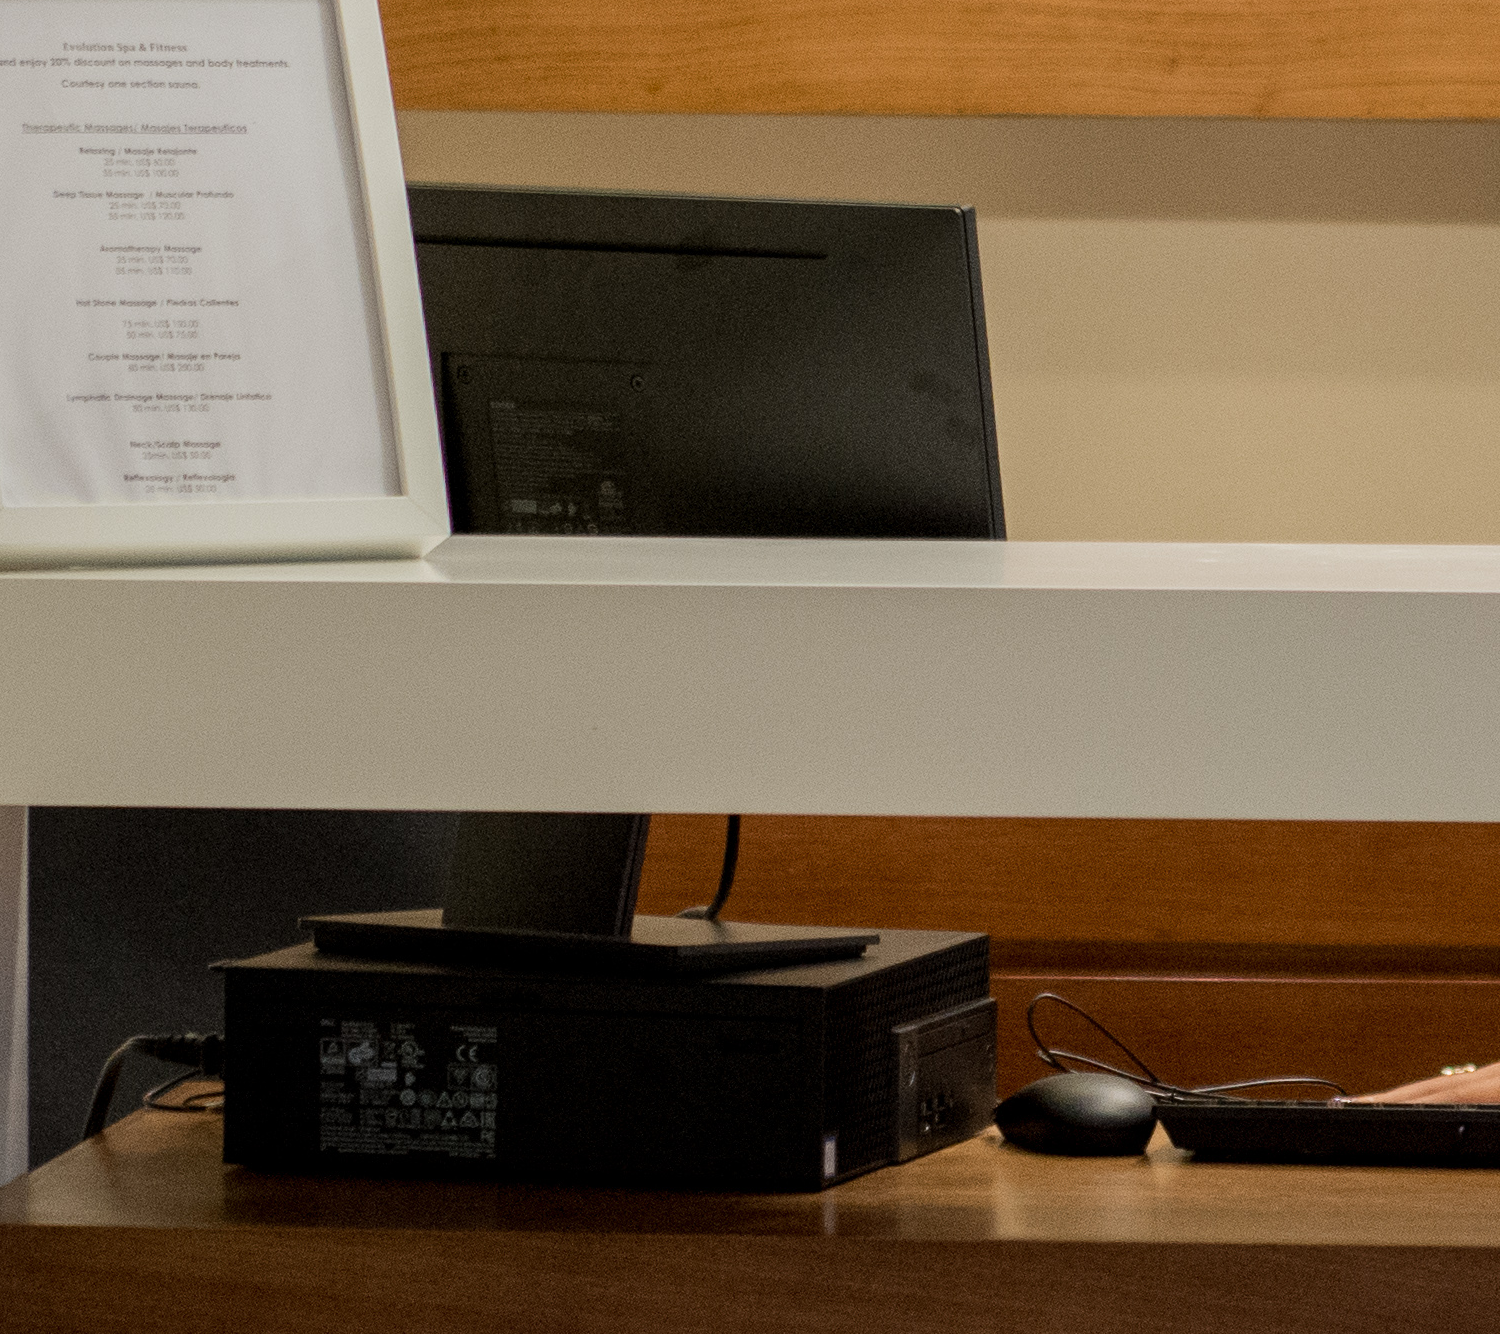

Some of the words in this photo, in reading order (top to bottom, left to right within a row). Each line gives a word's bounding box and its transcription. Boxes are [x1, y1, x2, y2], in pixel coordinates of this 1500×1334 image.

[62, 43, 115, 52] Evolution
[116, 43, 136, 54] Spa
[149, 43, 188, 52] Fitness
